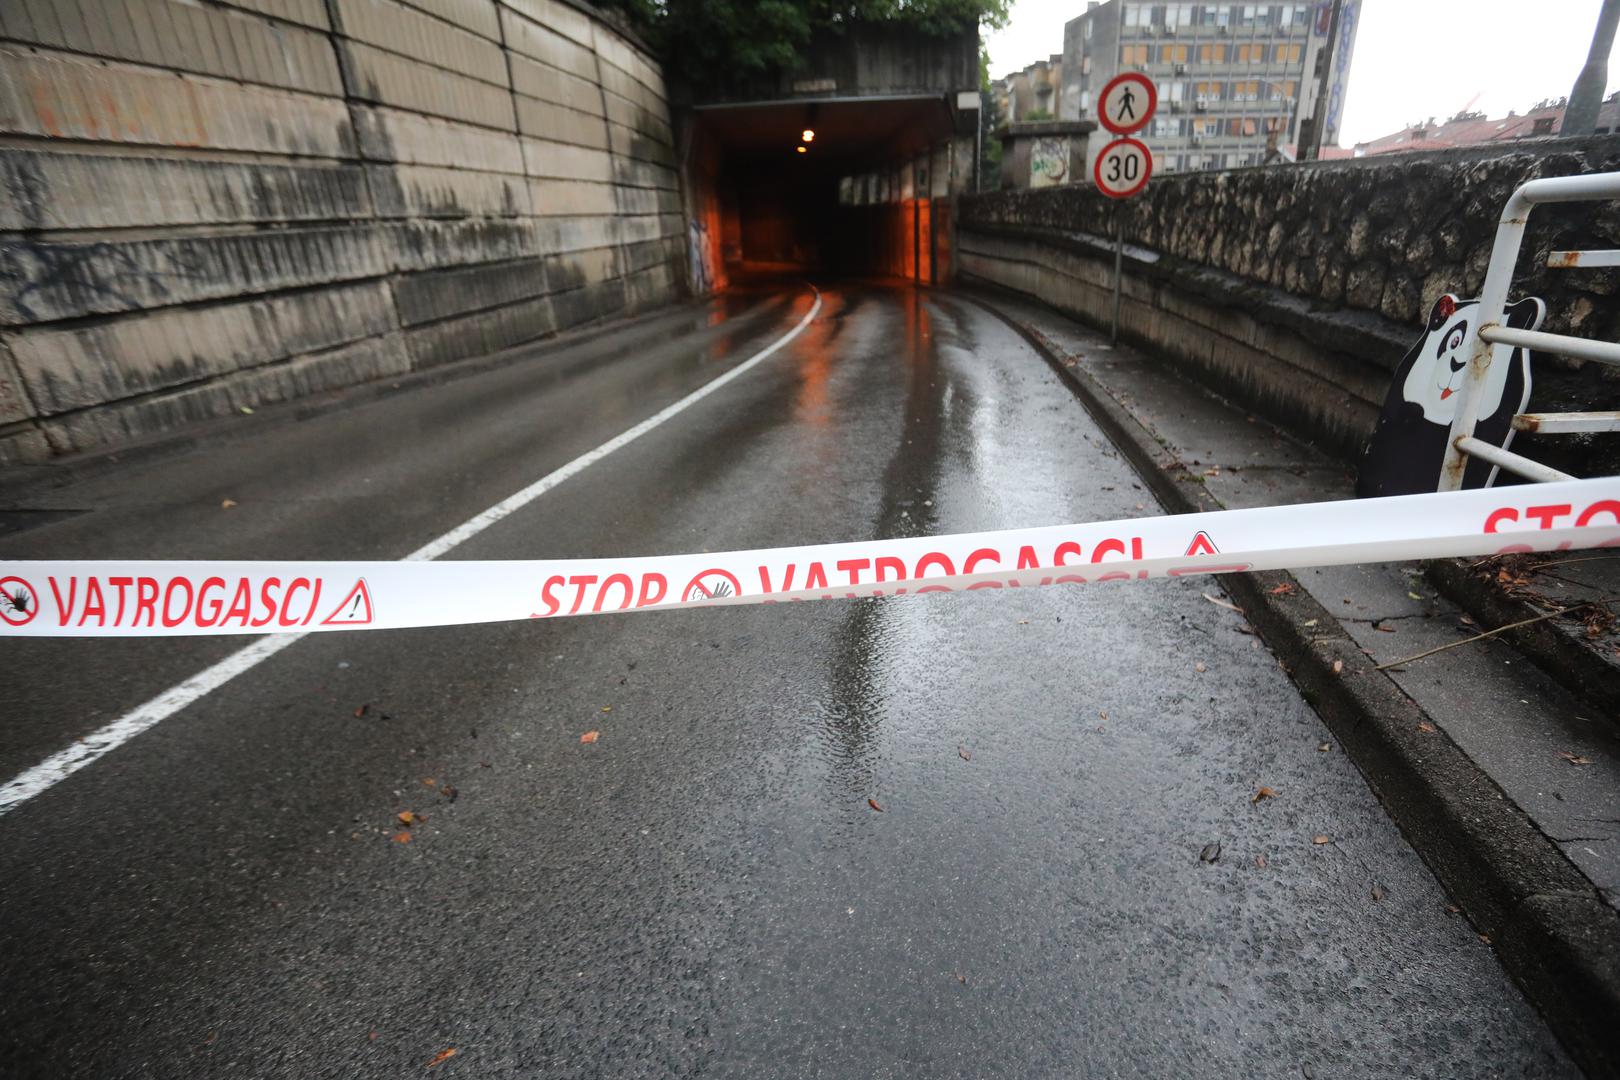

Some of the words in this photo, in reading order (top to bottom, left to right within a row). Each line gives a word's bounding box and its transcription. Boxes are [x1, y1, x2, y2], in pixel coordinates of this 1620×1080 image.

[1107, 153, 1139, 182] 30
[48, 576, 323, 628] VATROGASCI
[530, 572, 668, 618] STOP
